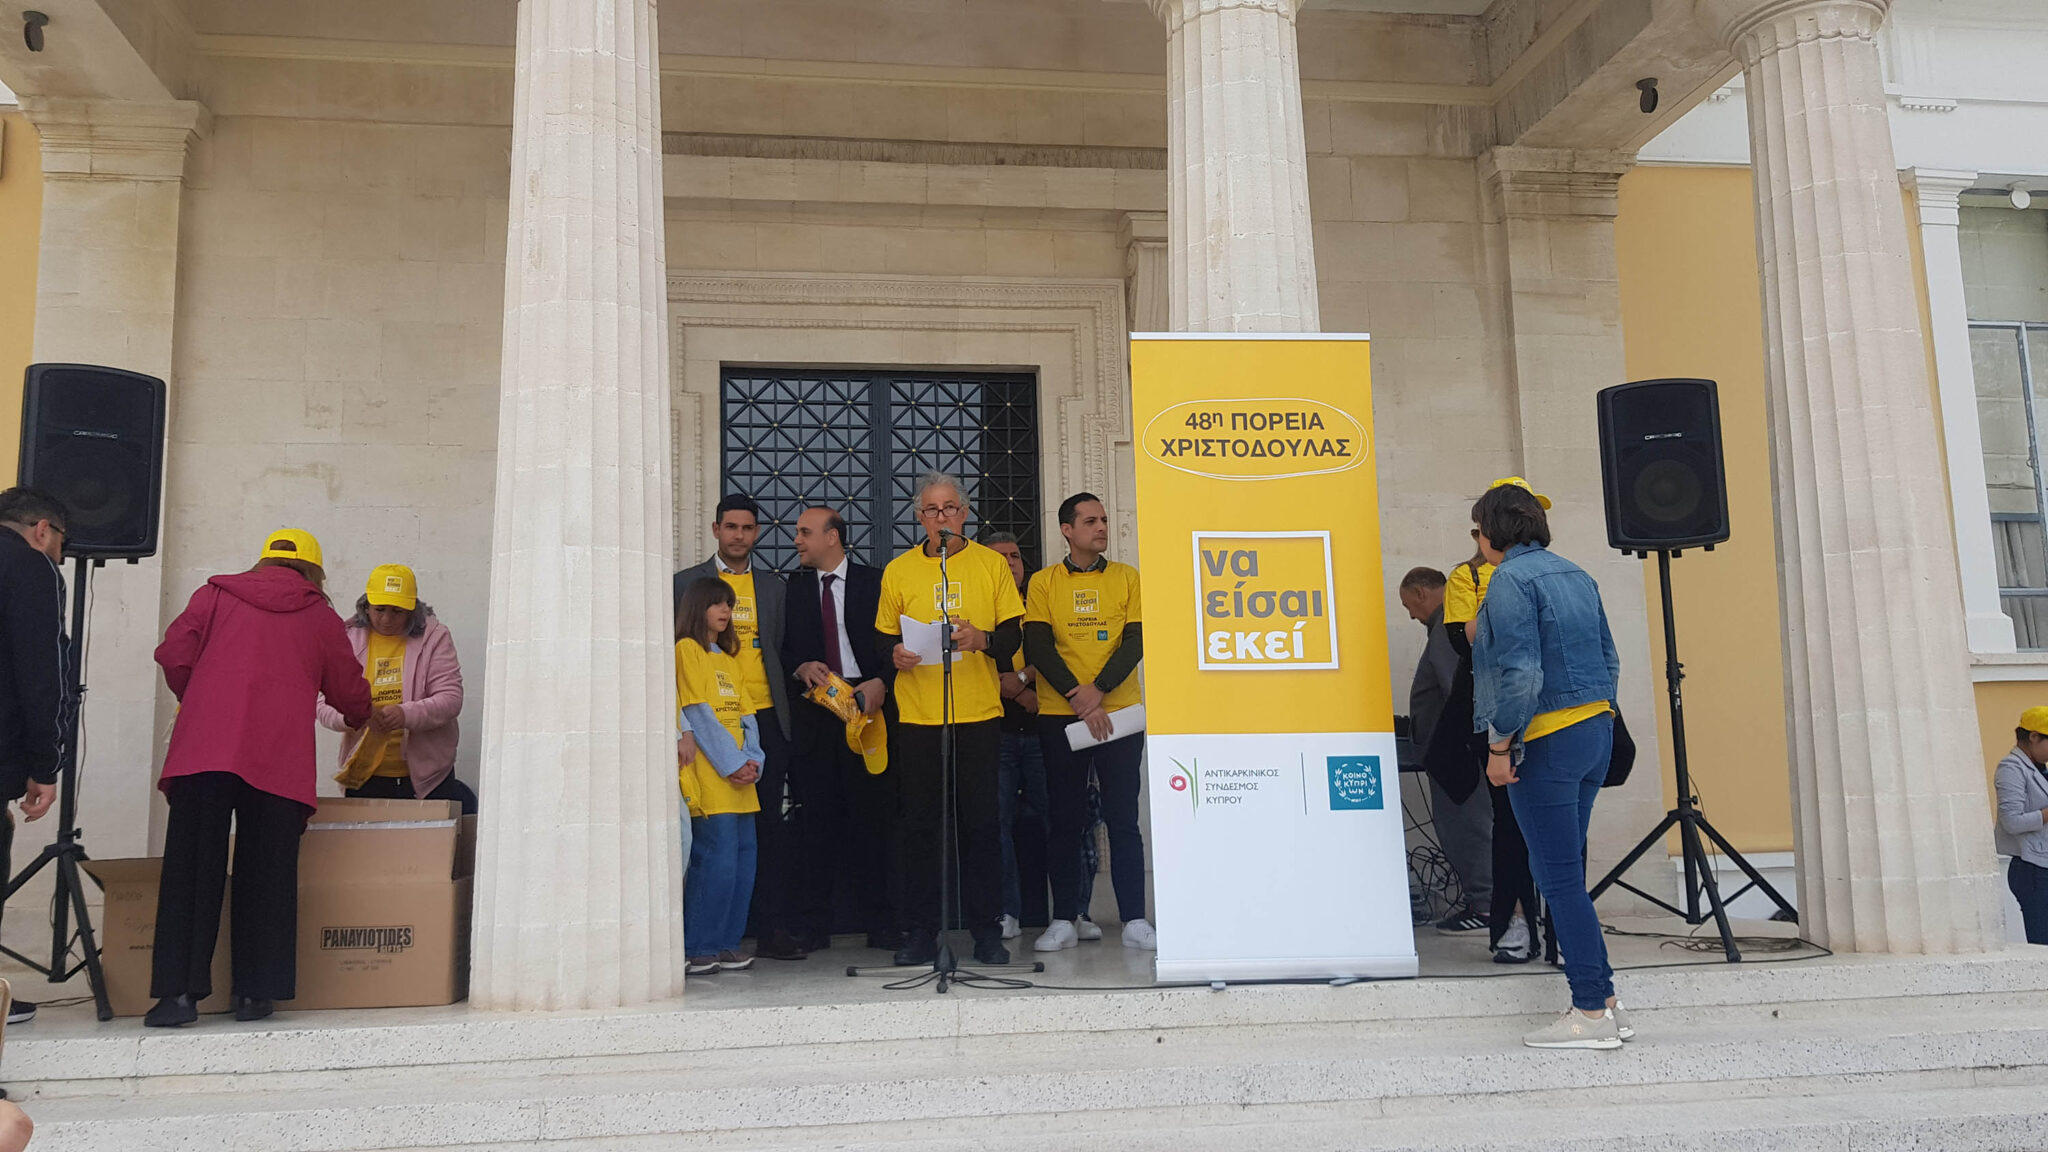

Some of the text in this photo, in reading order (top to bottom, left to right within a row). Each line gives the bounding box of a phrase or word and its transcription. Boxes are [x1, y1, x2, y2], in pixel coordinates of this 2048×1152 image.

[1231, 412, 1325, 431] ΠΟΡΕΙΑ
[1160, 438, 1351, 457] ΧΡΙΣΤΟΔΟΥΛΑΣ
[1202, 549, 1259, 577] να
[1206, 581, 1323, 618] είσαι
[1208, 621, 1307, 660] εκεί
[1204, 769, 1280, 778] ΑΝΤΙΚΑΡΚΙΝΙΚΟΣ
[1343, 772, 1367, 780] ΚΟΙΝΟ
[1344, 779, 1367, 787] ΚΥΠΡΙ
[1205, 783, 1259, 791] ΣΥΝΔΕΣΜΟΣ
[1206, 796, 1242, 804] ΚΥΠΡΟΥ
[323, 928, 411, 947] PANAYIOTIDES
